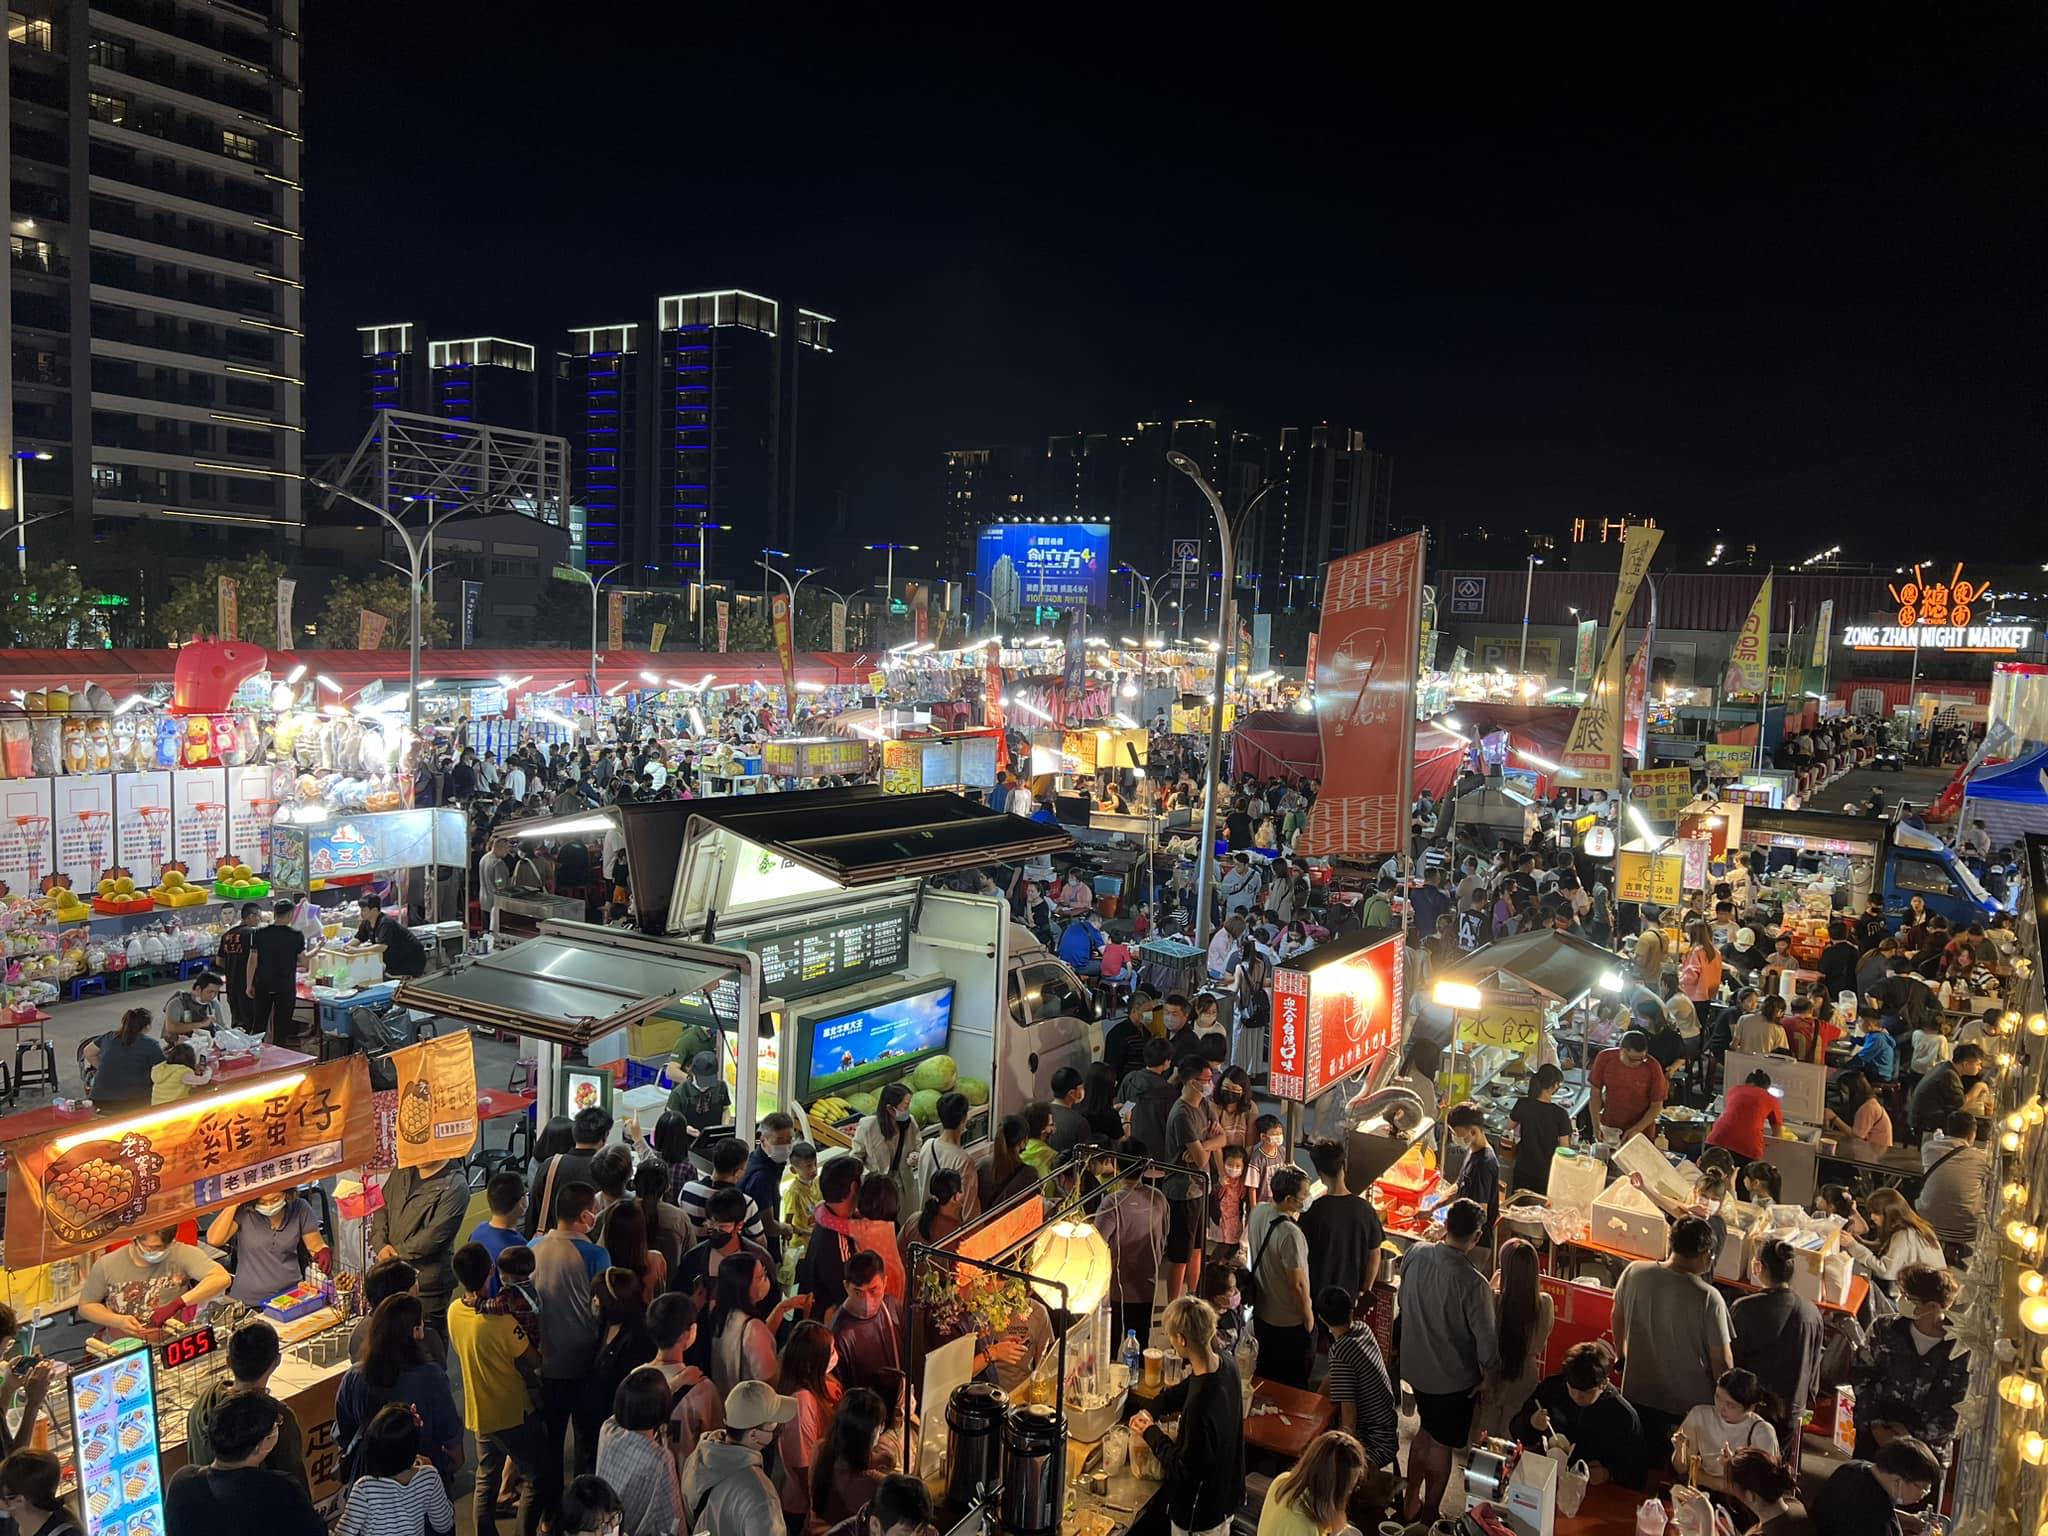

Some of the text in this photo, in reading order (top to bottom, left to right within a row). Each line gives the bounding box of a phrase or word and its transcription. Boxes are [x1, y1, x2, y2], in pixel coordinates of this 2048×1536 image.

[1842, 626, 2033, 649] ZONG ZHAN NIGHT MARKET
[1280, 996, 1298, 1072] 迎合台灣口味
[1463, 1016, 1536, 1045] 水餃
[199, 1088, 342, 1170] 雞蛋仔
[60, 1223, 75, 1239] Egg
